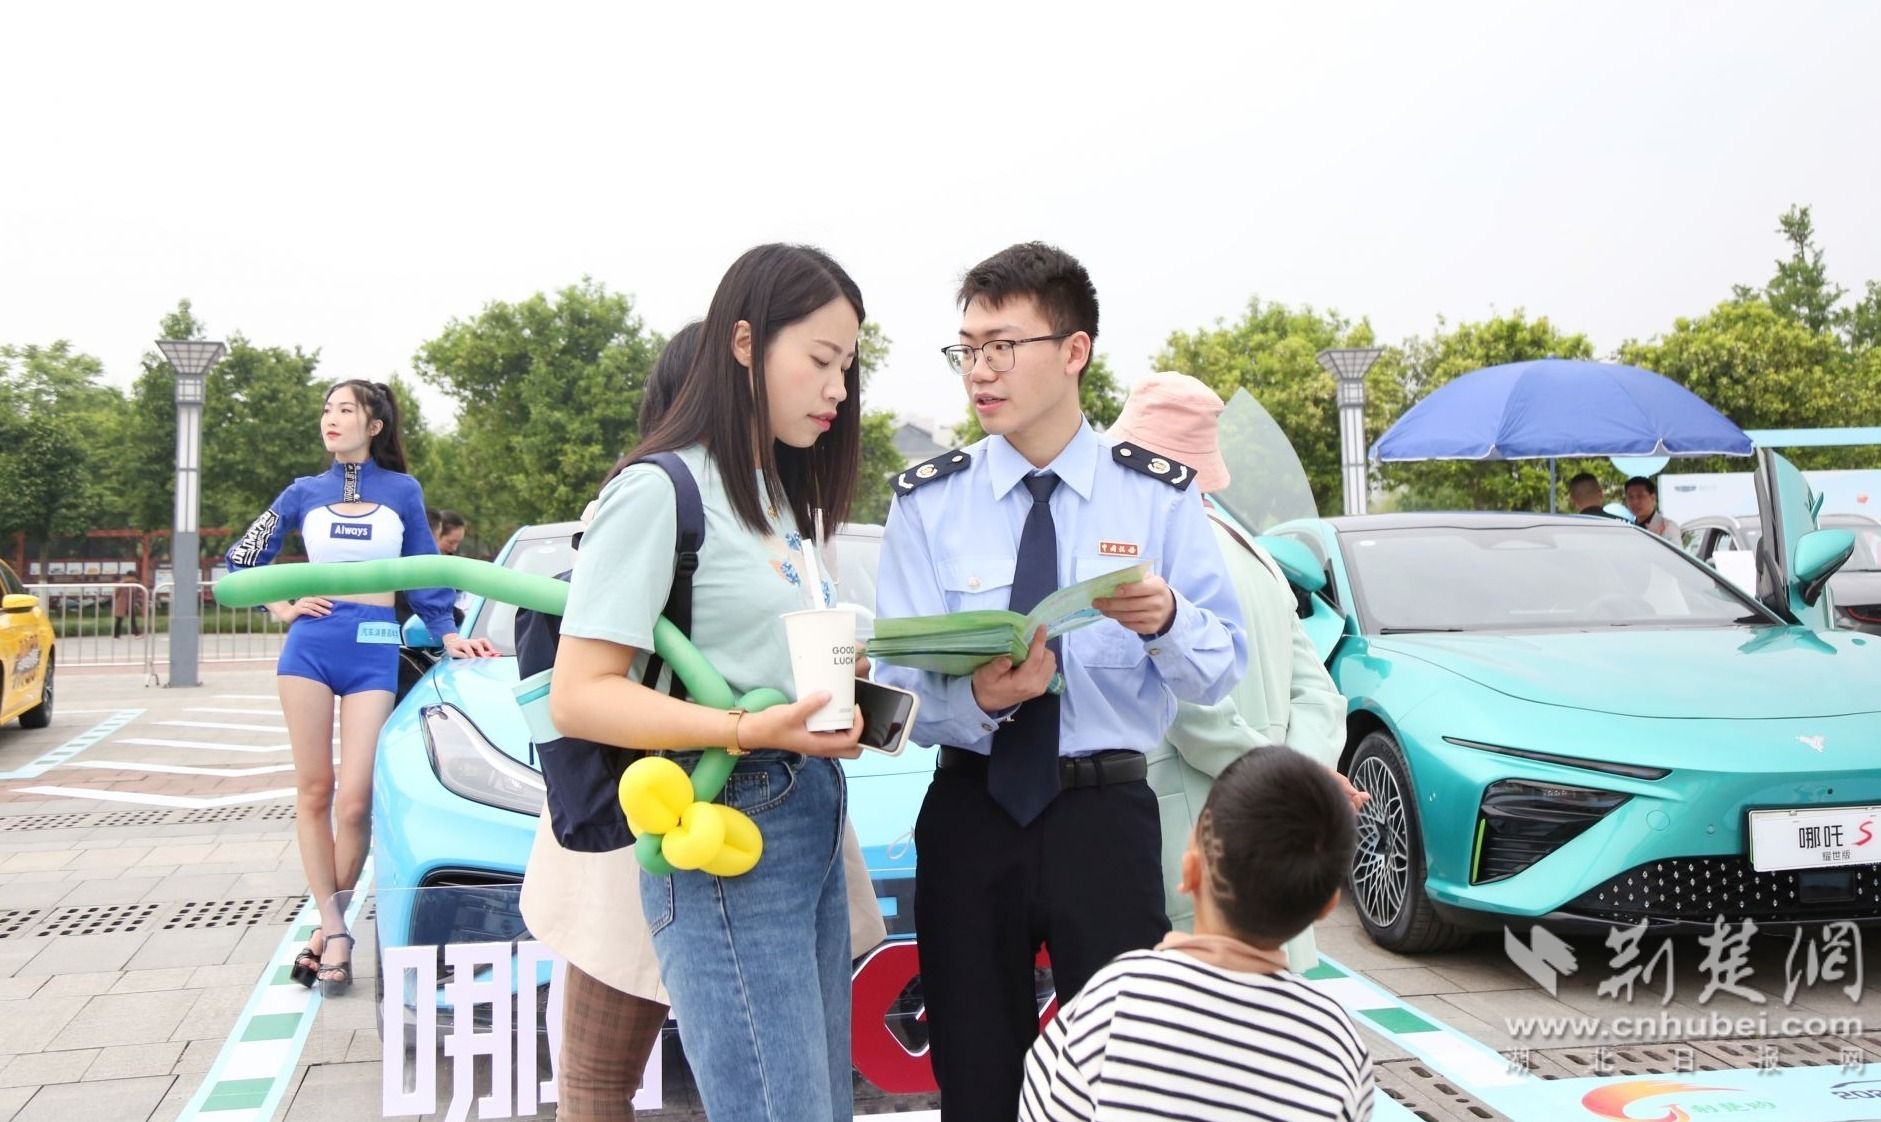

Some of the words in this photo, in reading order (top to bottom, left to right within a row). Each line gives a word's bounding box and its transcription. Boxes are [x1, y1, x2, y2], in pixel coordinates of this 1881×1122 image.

[334, 525, 368, 537] Always
[1799, 825, 1843, 848] 哪吒
[1851, 820, 1873, 846] S
